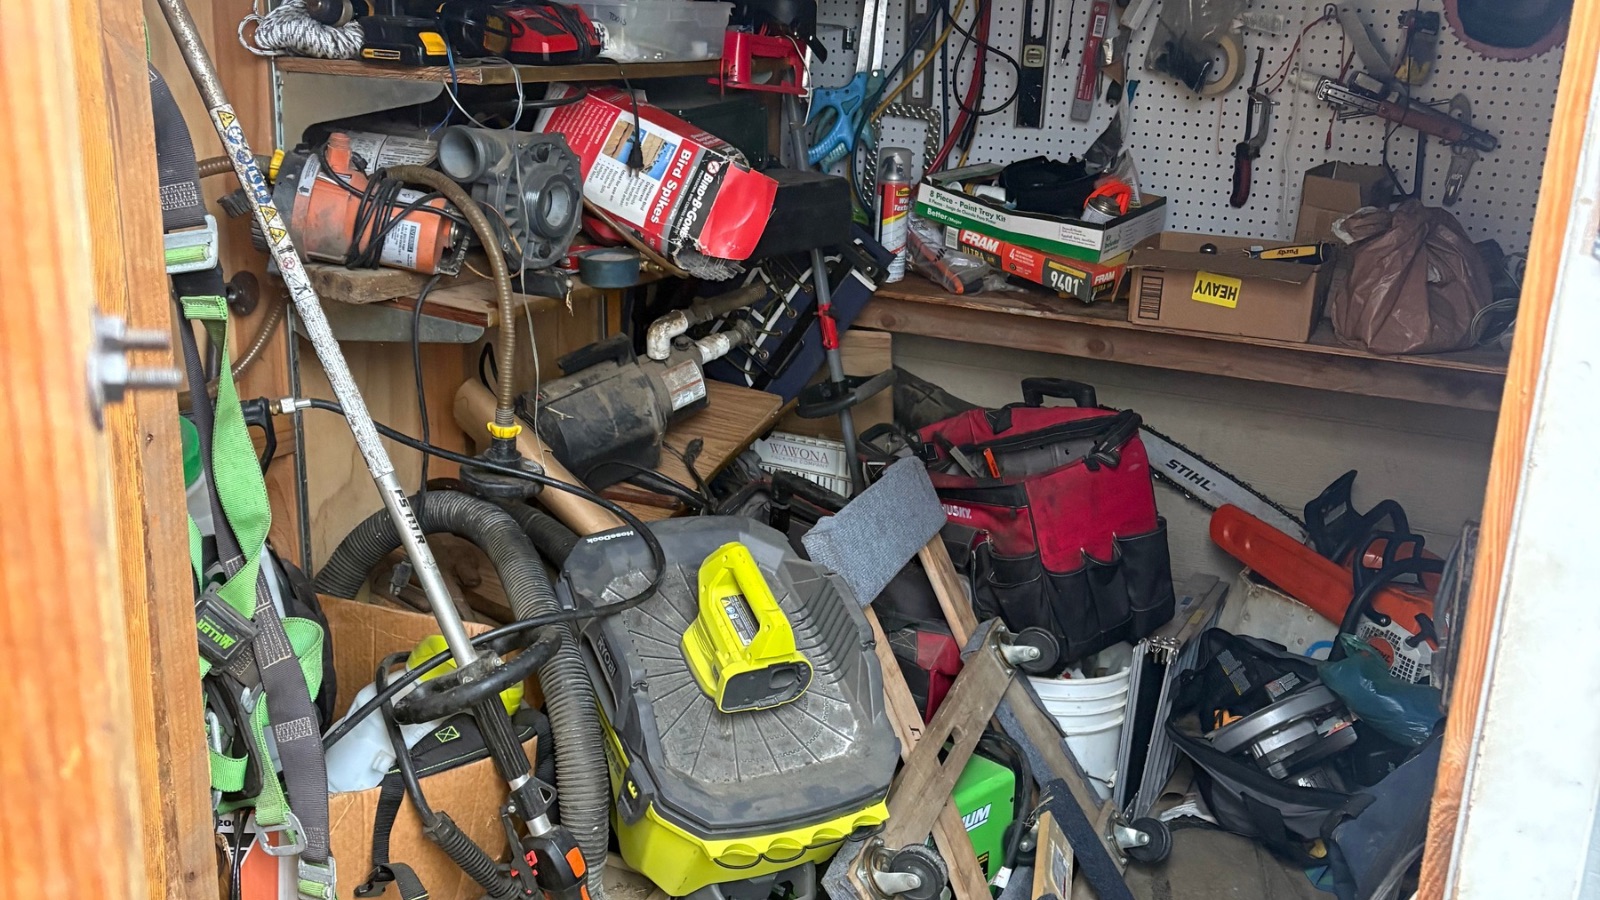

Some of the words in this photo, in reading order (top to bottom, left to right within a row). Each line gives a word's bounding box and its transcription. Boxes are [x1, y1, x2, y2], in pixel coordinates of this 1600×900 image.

[672, 148, 691, 179] Bird
[651, 180, 678, 224] Spikes
[926, 208, 947, 220] Better
[930, 190, 934, 198] 8
[936, 192, 954, 204] Piece
[960, 200, 978, 212] Paint
[979, 208, 996, 220] Tray
[996, 214, 1006, 222] Kit
[962, 230, 1000, 253] FRAM
[1276, 248, 1299, 256] Purdy
[1009, 248, 1015, 260] 4
[1050, 270, 1080, 296] 9401
[1094, 270, 1116, 285] FRAM
[1195, 280, 1239, 302] HEAVY
[768, 442, 830, 463] WAWONA
[1165, 458, 1211, 491] STIHL
[393, 487, 409, 508] FS
[415, 532, 426, 545] R
[586, 530, 633, 543] HoseDock
[197, 620, 235, 650] MILLER
[596, 638, 617, 676] RYOBI
